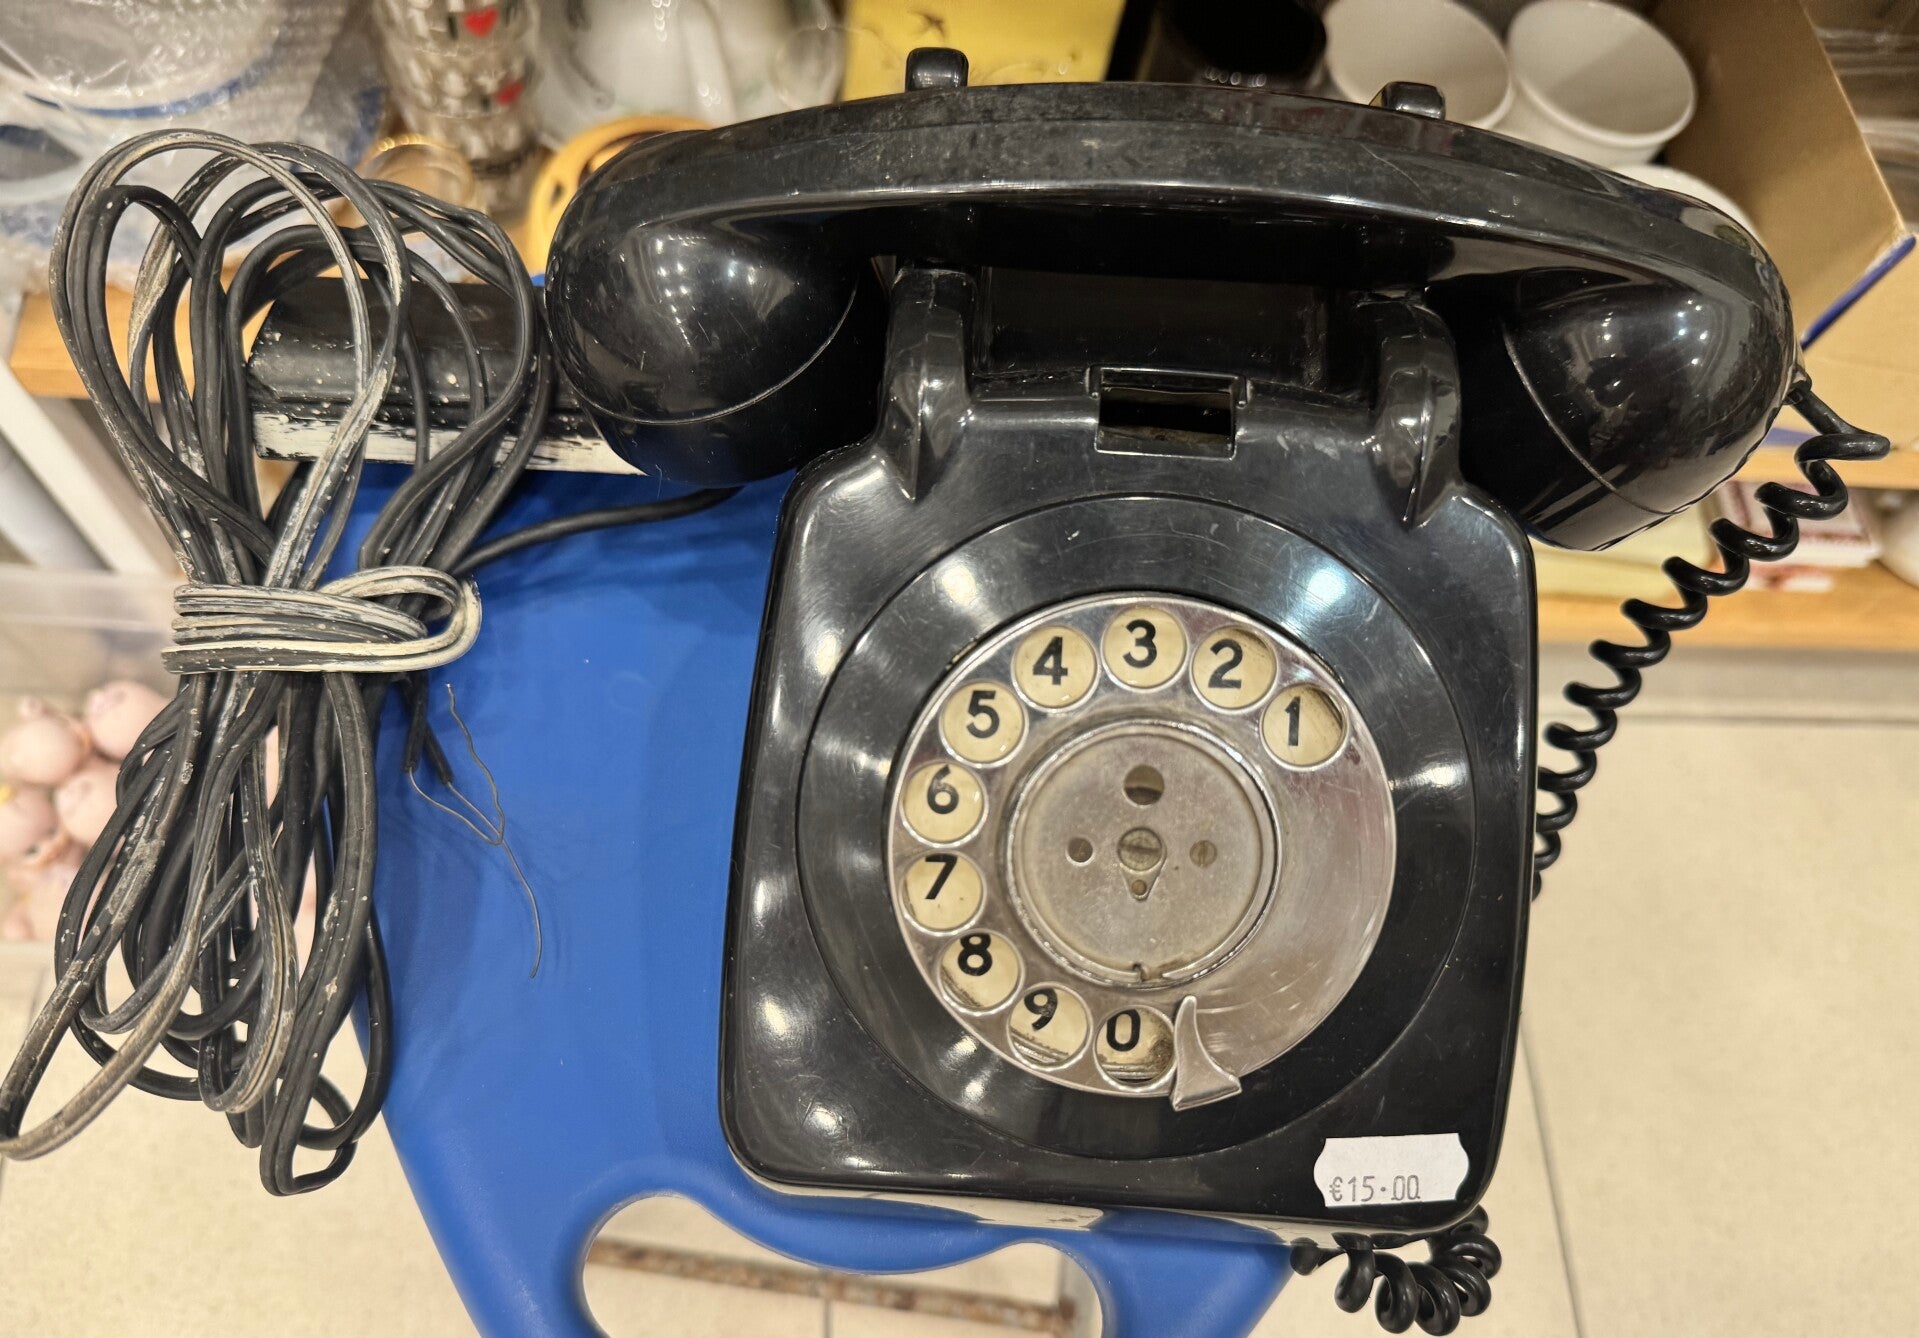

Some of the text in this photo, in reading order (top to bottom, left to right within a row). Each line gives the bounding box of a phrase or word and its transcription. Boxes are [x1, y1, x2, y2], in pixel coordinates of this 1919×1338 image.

[1032, 636, 1068, 685] 4
[1123, 619, 1157, 668] 3
[1208, 640, 1243, 688] 2
[966, 690, 1000, 739] 5
[1285, 696, 1301, 747] 1
[926, 765, 960, 815] 6
[924, 855, 958, 900] 7
[957, 933, 992, 977] 8
[1023, 988, 1058, 1032] 9
[1106, 1009, 1141, 1052] 0
